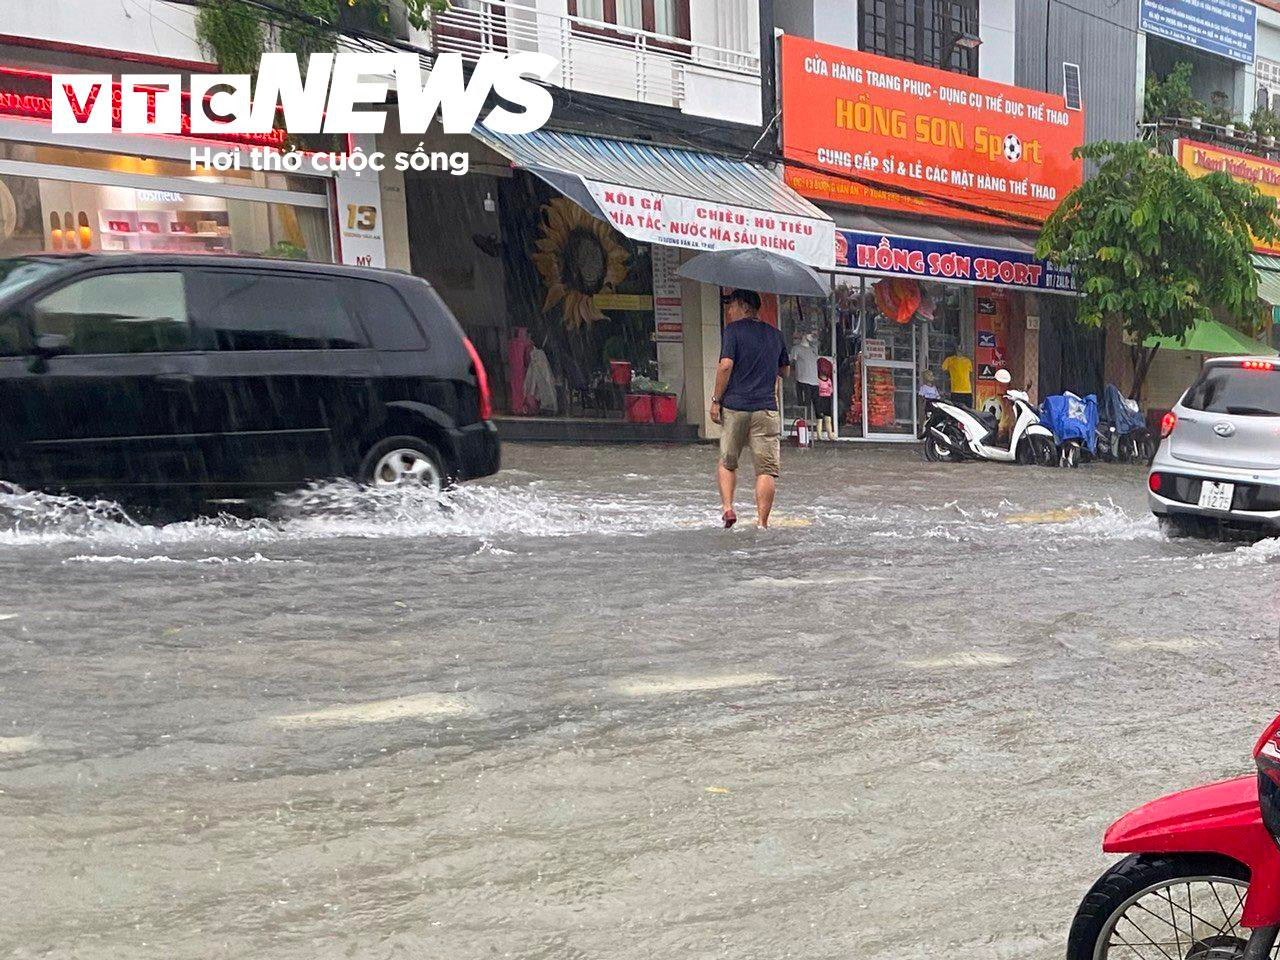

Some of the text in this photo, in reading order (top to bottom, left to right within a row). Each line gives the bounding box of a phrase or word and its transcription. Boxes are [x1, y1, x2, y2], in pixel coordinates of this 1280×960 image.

[804, 53, 829, 77] CỬA
[832, 62, 862, 84] HÀNG
[866, 69, 901, 92] TRANG
[903, 78, 931, 100] PHỤC
[939, 86, 967, 106] DỤNG
[969, 93, 983, 112] CỤ
[985, 94, 1004, 113] THỂ
[1005, 101, 1024, 118] DỤC
[1026, 102, 1045, 122] THỂ
[1046, 108, 1069, 127] THAO
[817, 147, 852, 170] CUNG
[854, 150, 879, 171] CẤP
[897, 161, 906, 176] &
[909, 159, 922, 179] LẺ
[925, 164, 948, 183] CÁC
[951, 169, 975, 192] MẶT
[977, 173, 1007, 193] HÀNG
[1009, 177, 1029, 196] THỂ
[1030, 182, 1057, 200] THAO
[1194, 149, 1220, 171] Nem
[347, 204, 378, 232] 13
[856, 236, 925, 274] HỒNG
[927, 251, 971, 278] SƠN
[973, 257, 1042, 286] SPORT
